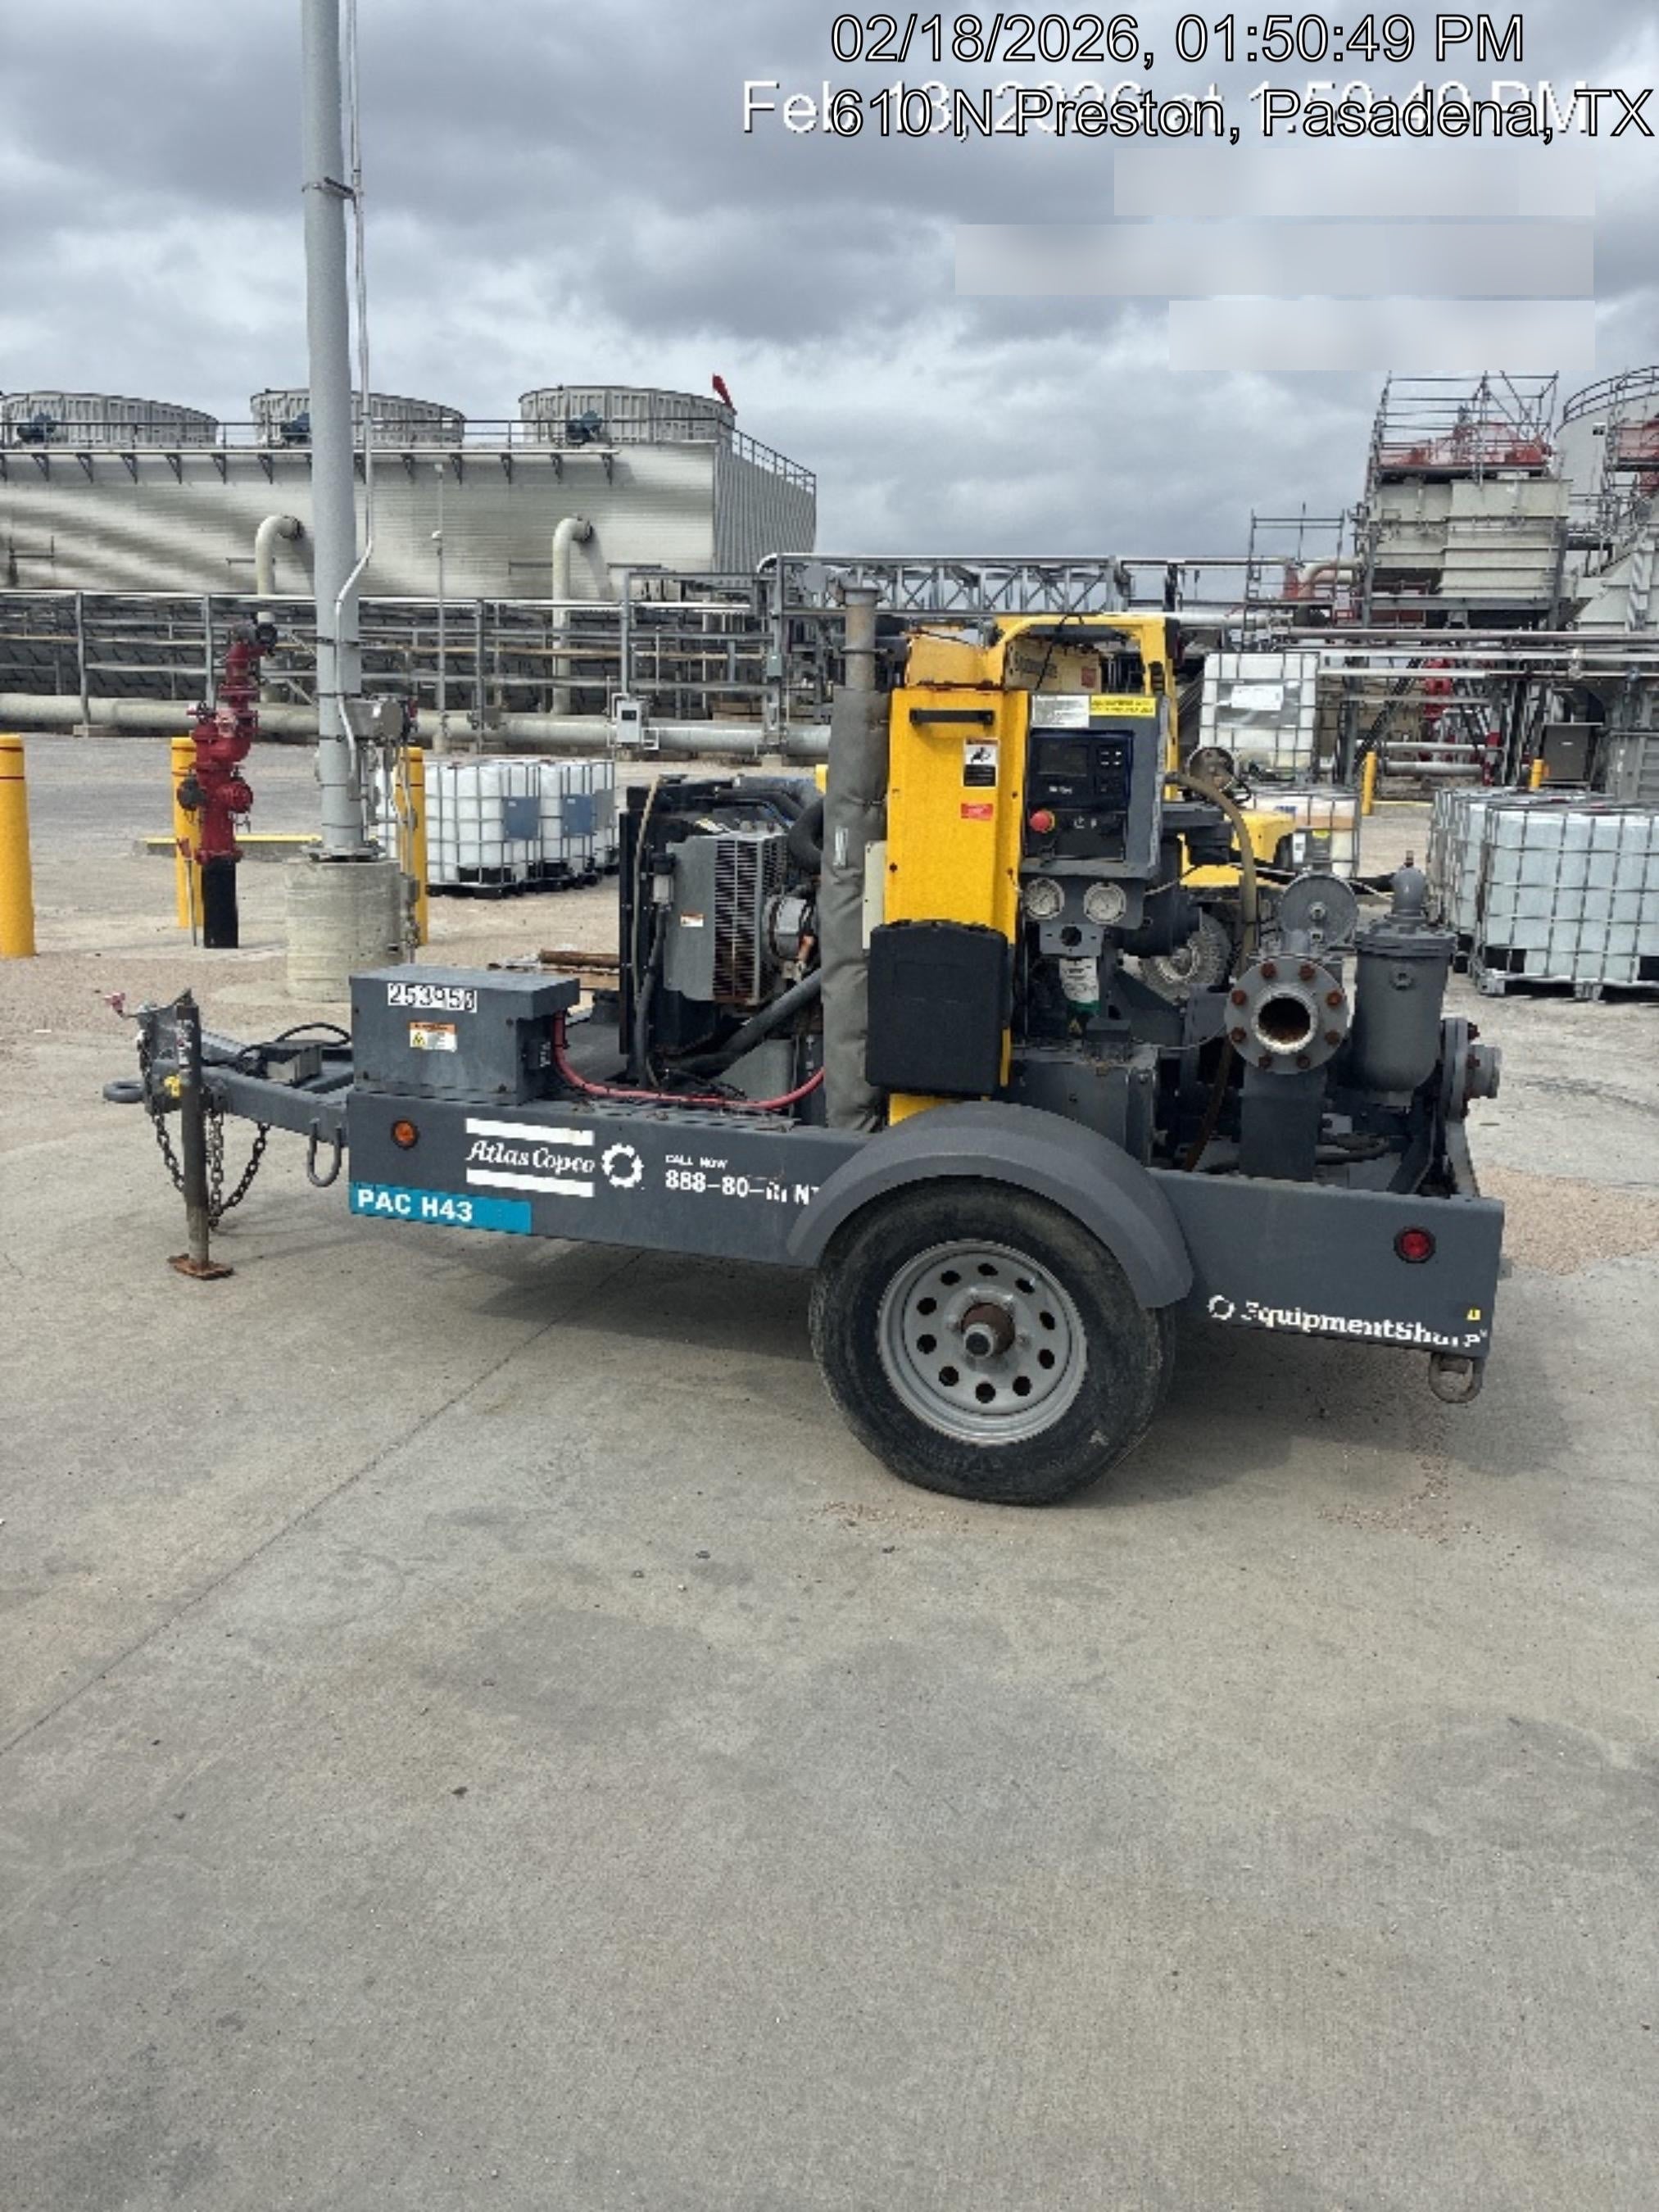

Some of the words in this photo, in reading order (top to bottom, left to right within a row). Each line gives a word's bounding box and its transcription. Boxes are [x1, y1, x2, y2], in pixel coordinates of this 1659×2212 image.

[465, 1140, 530, 1167] Atlas
[532, 1147, 596, 1176] Copco
[356, 1188, 411, 1215] PAC
[421, 1195, 474, 1222] H43
